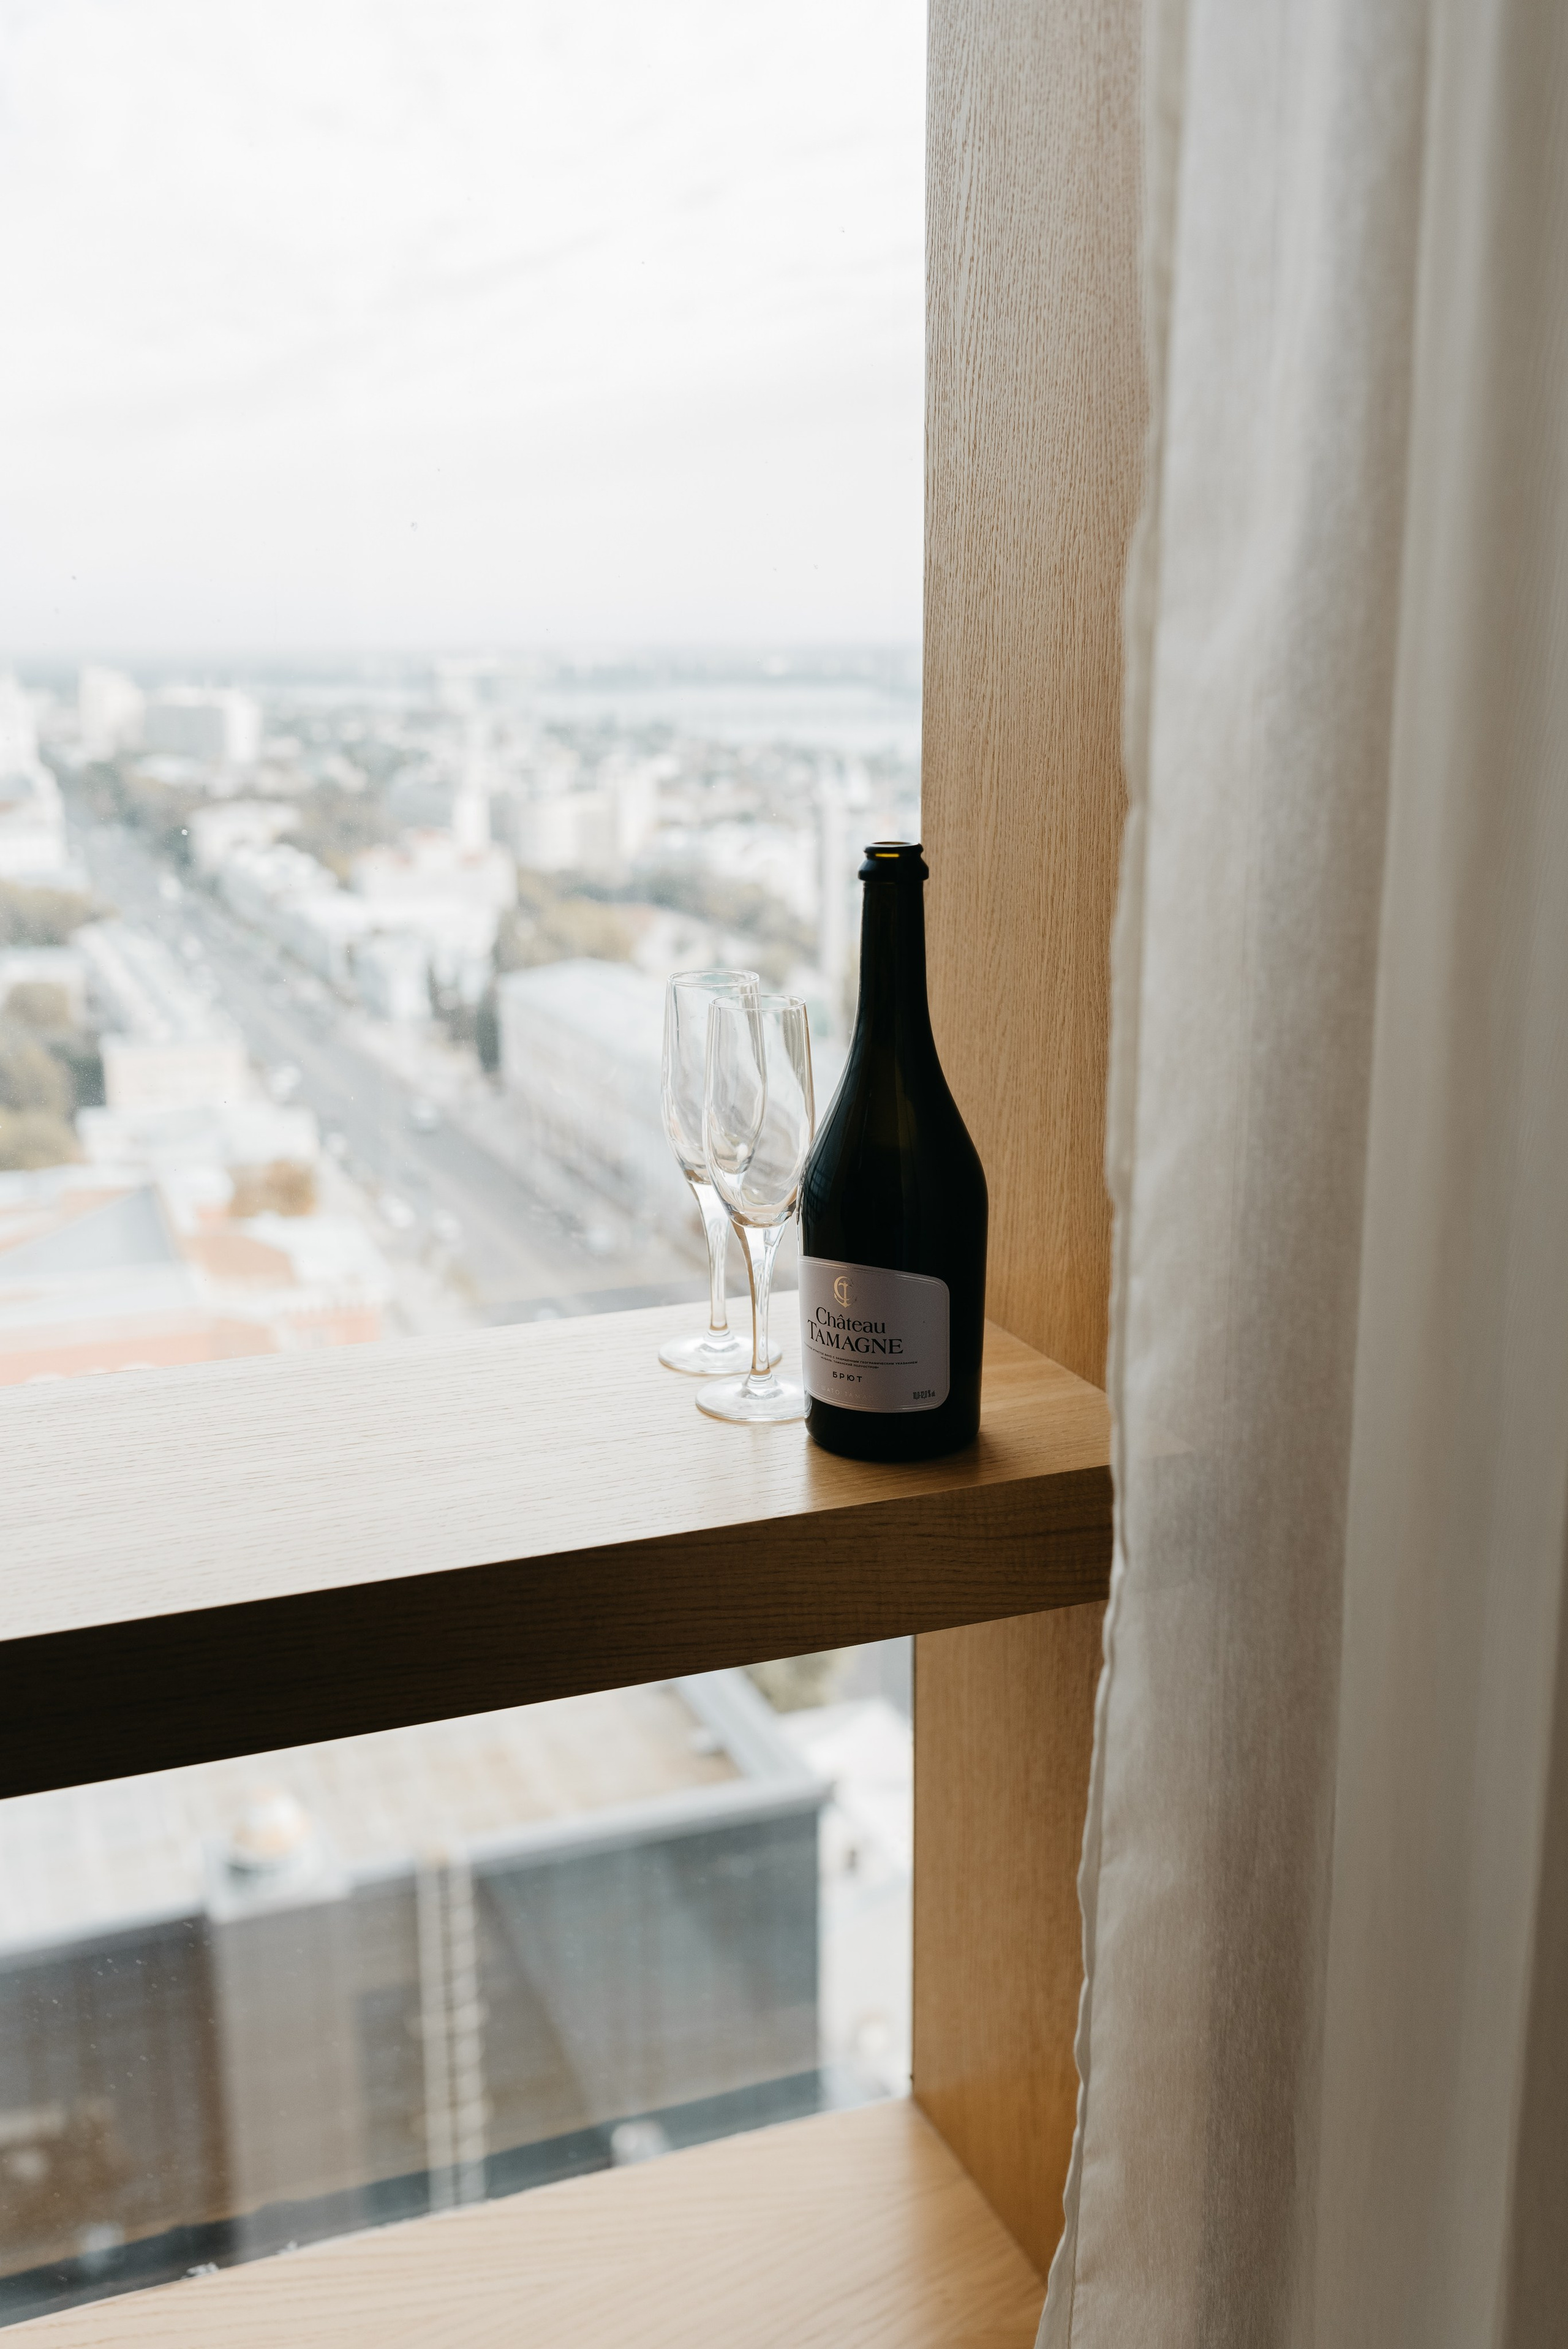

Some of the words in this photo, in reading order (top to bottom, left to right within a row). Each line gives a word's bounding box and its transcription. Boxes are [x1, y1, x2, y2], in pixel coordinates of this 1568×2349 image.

[816, 1306, 886, 1334] Château
[807, 1319, 903, 1354] TAMAGNE
[833, 1371, 863, 1382] БРЮТ
[821, 1385, 840, 1395] ШАТО
